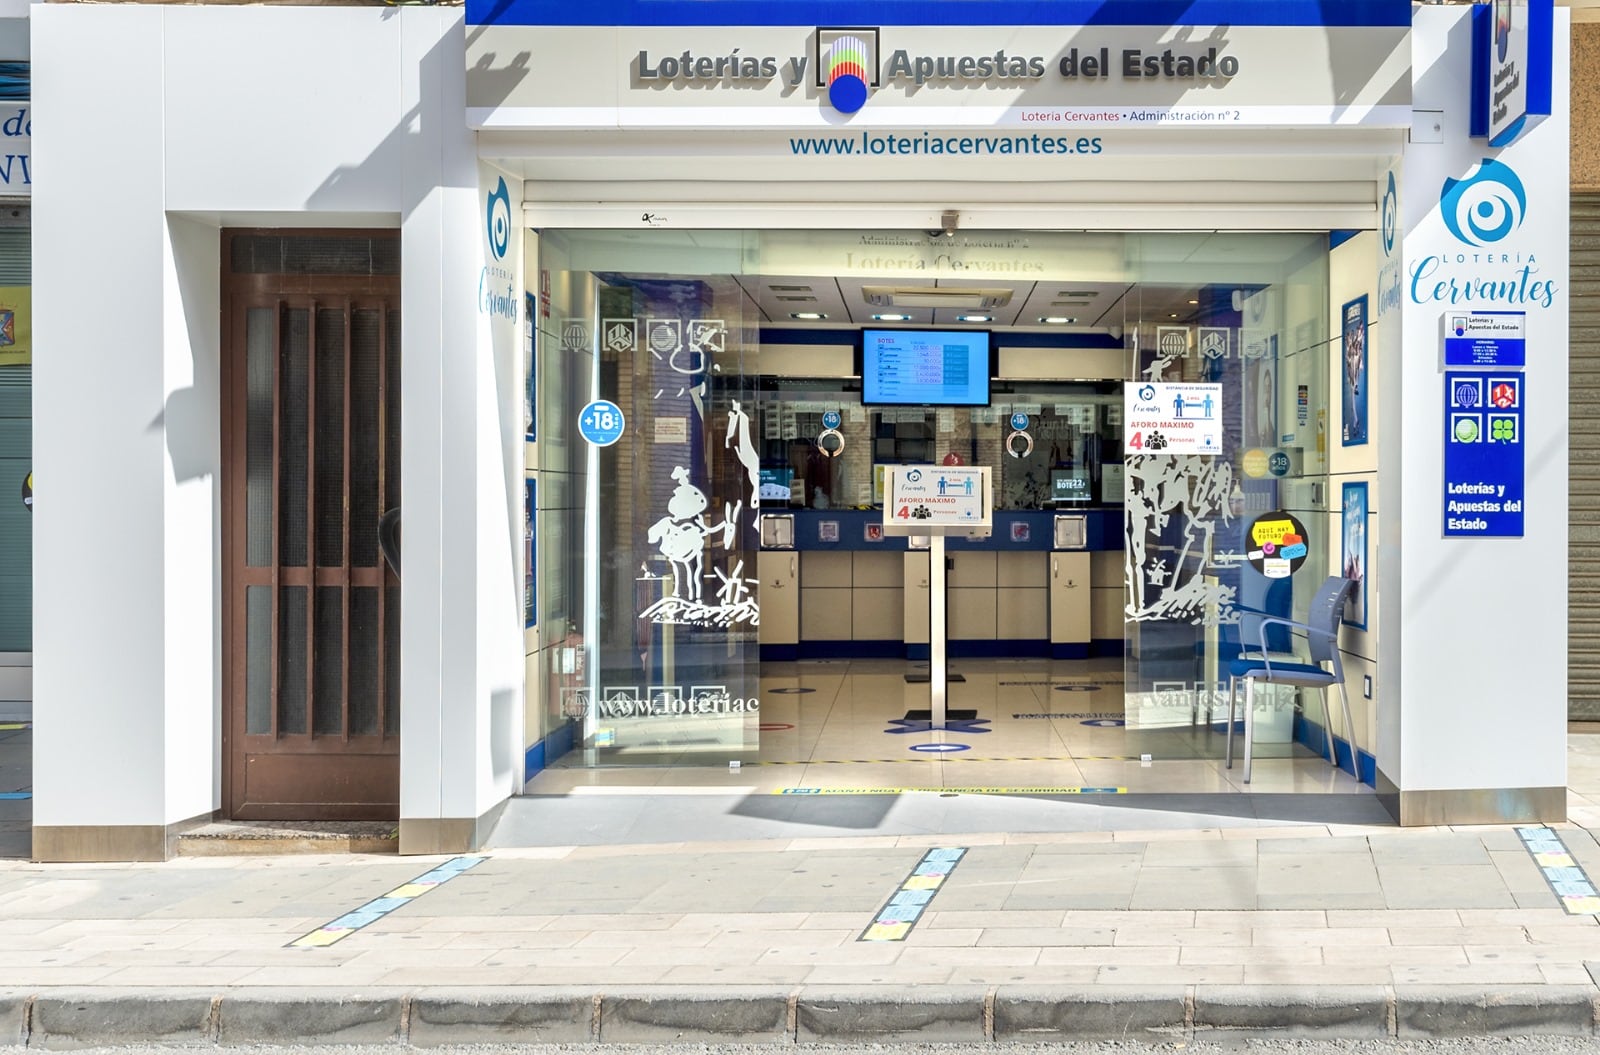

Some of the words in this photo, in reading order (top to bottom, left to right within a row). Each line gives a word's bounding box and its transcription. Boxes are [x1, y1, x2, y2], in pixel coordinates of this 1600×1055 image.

[639, 48, 778, 79] Loterías
[790, 56, 808, 85] y
[889, 50, 1045, 86] Apuestas
[1059, 48, 1109, 78] del
[1122, 48, 1240, 78] Estado
[1064, 111, 1120, 121] Cervantes
[1129, 110, 1214, 121] Administración
[1233, 110, 1241, 121] 2
[790, 131, 1103, 155] www.loteriacervantes.es
[1442, 253, 1536, 264] LOTERÍA
[1409, 256, 1559, 309] Cervantes
[584, 411, 613, 430] +18
[1130, 421, 1158, 429] AFORO
[1160, 421, 1195, 429] MAXIMO
[1129, 431, 1143, 450] 4
[1271, 457, 1287, 466] +18
[1448, 482, 1495, 495] Loterías
[1497, 485, 1505, 498] y
[897, 505, 910, 520] 4
[1448, 500, 1501, 514] Apuestas
[1503, 500, 1522, 513] del
[1448, 518, 1487, 530] Estado
